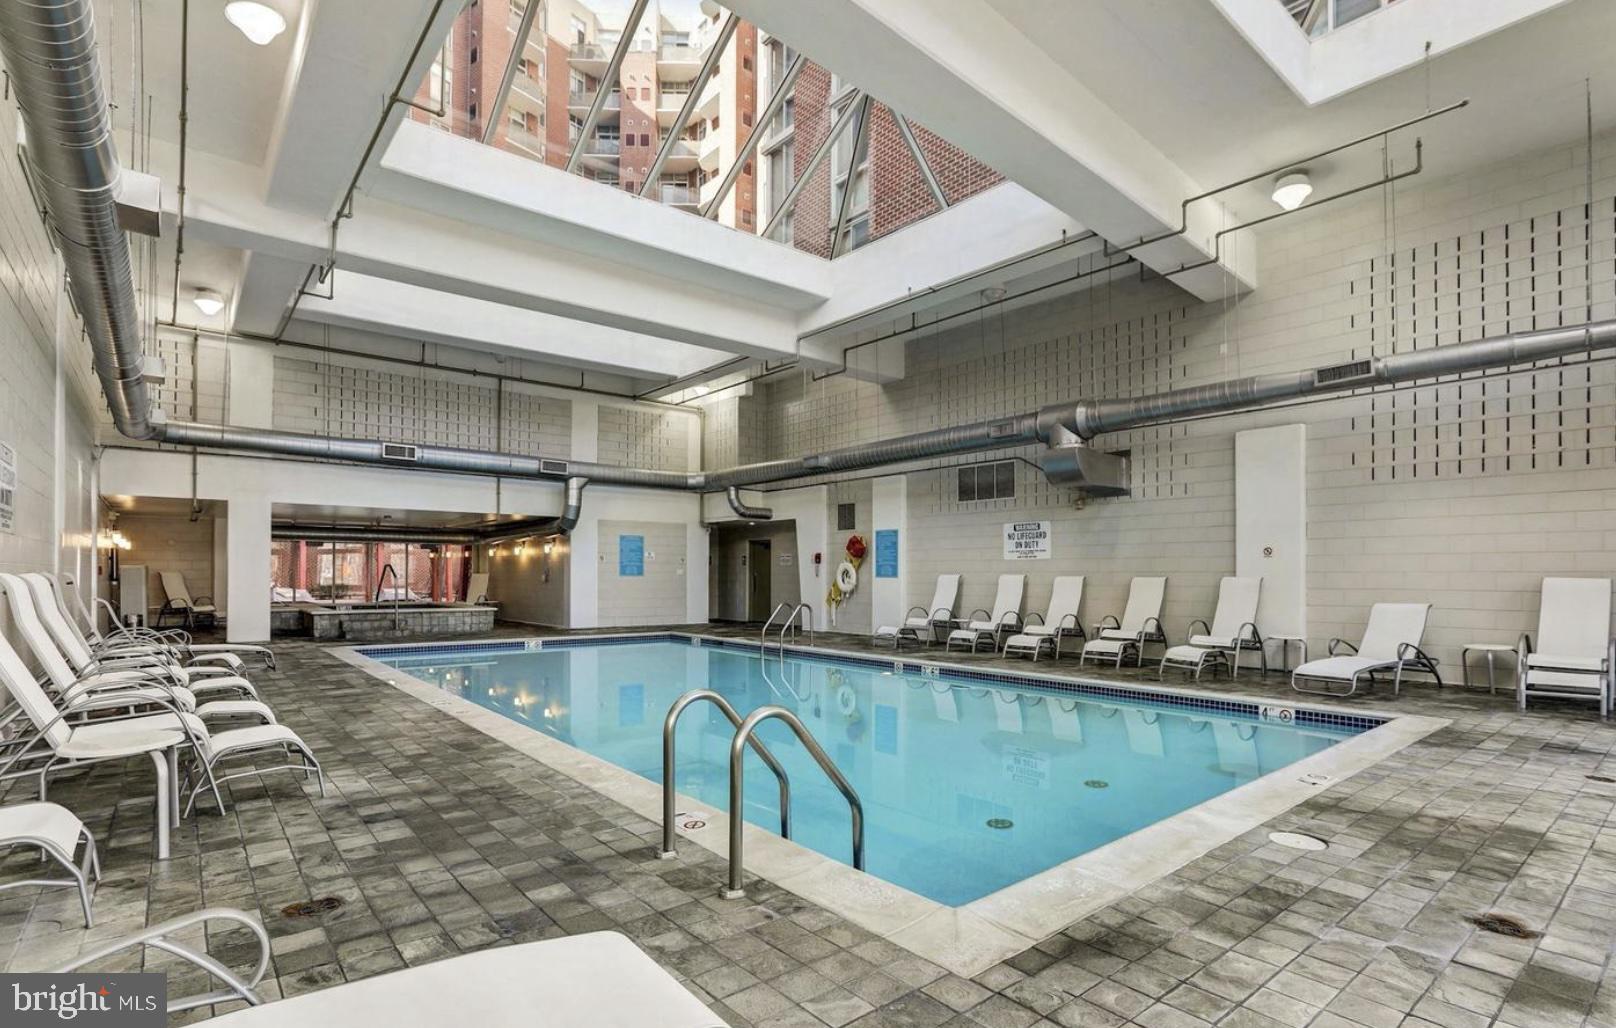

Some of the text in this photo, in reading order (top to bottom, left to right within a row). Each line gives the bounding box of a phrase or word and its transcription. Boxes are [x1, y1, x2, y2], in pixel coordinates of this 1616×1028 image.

[1007, 531, 1047, 541] NO LIFEGUARD
[1015, 540, 1039, 549] ON DUTY
